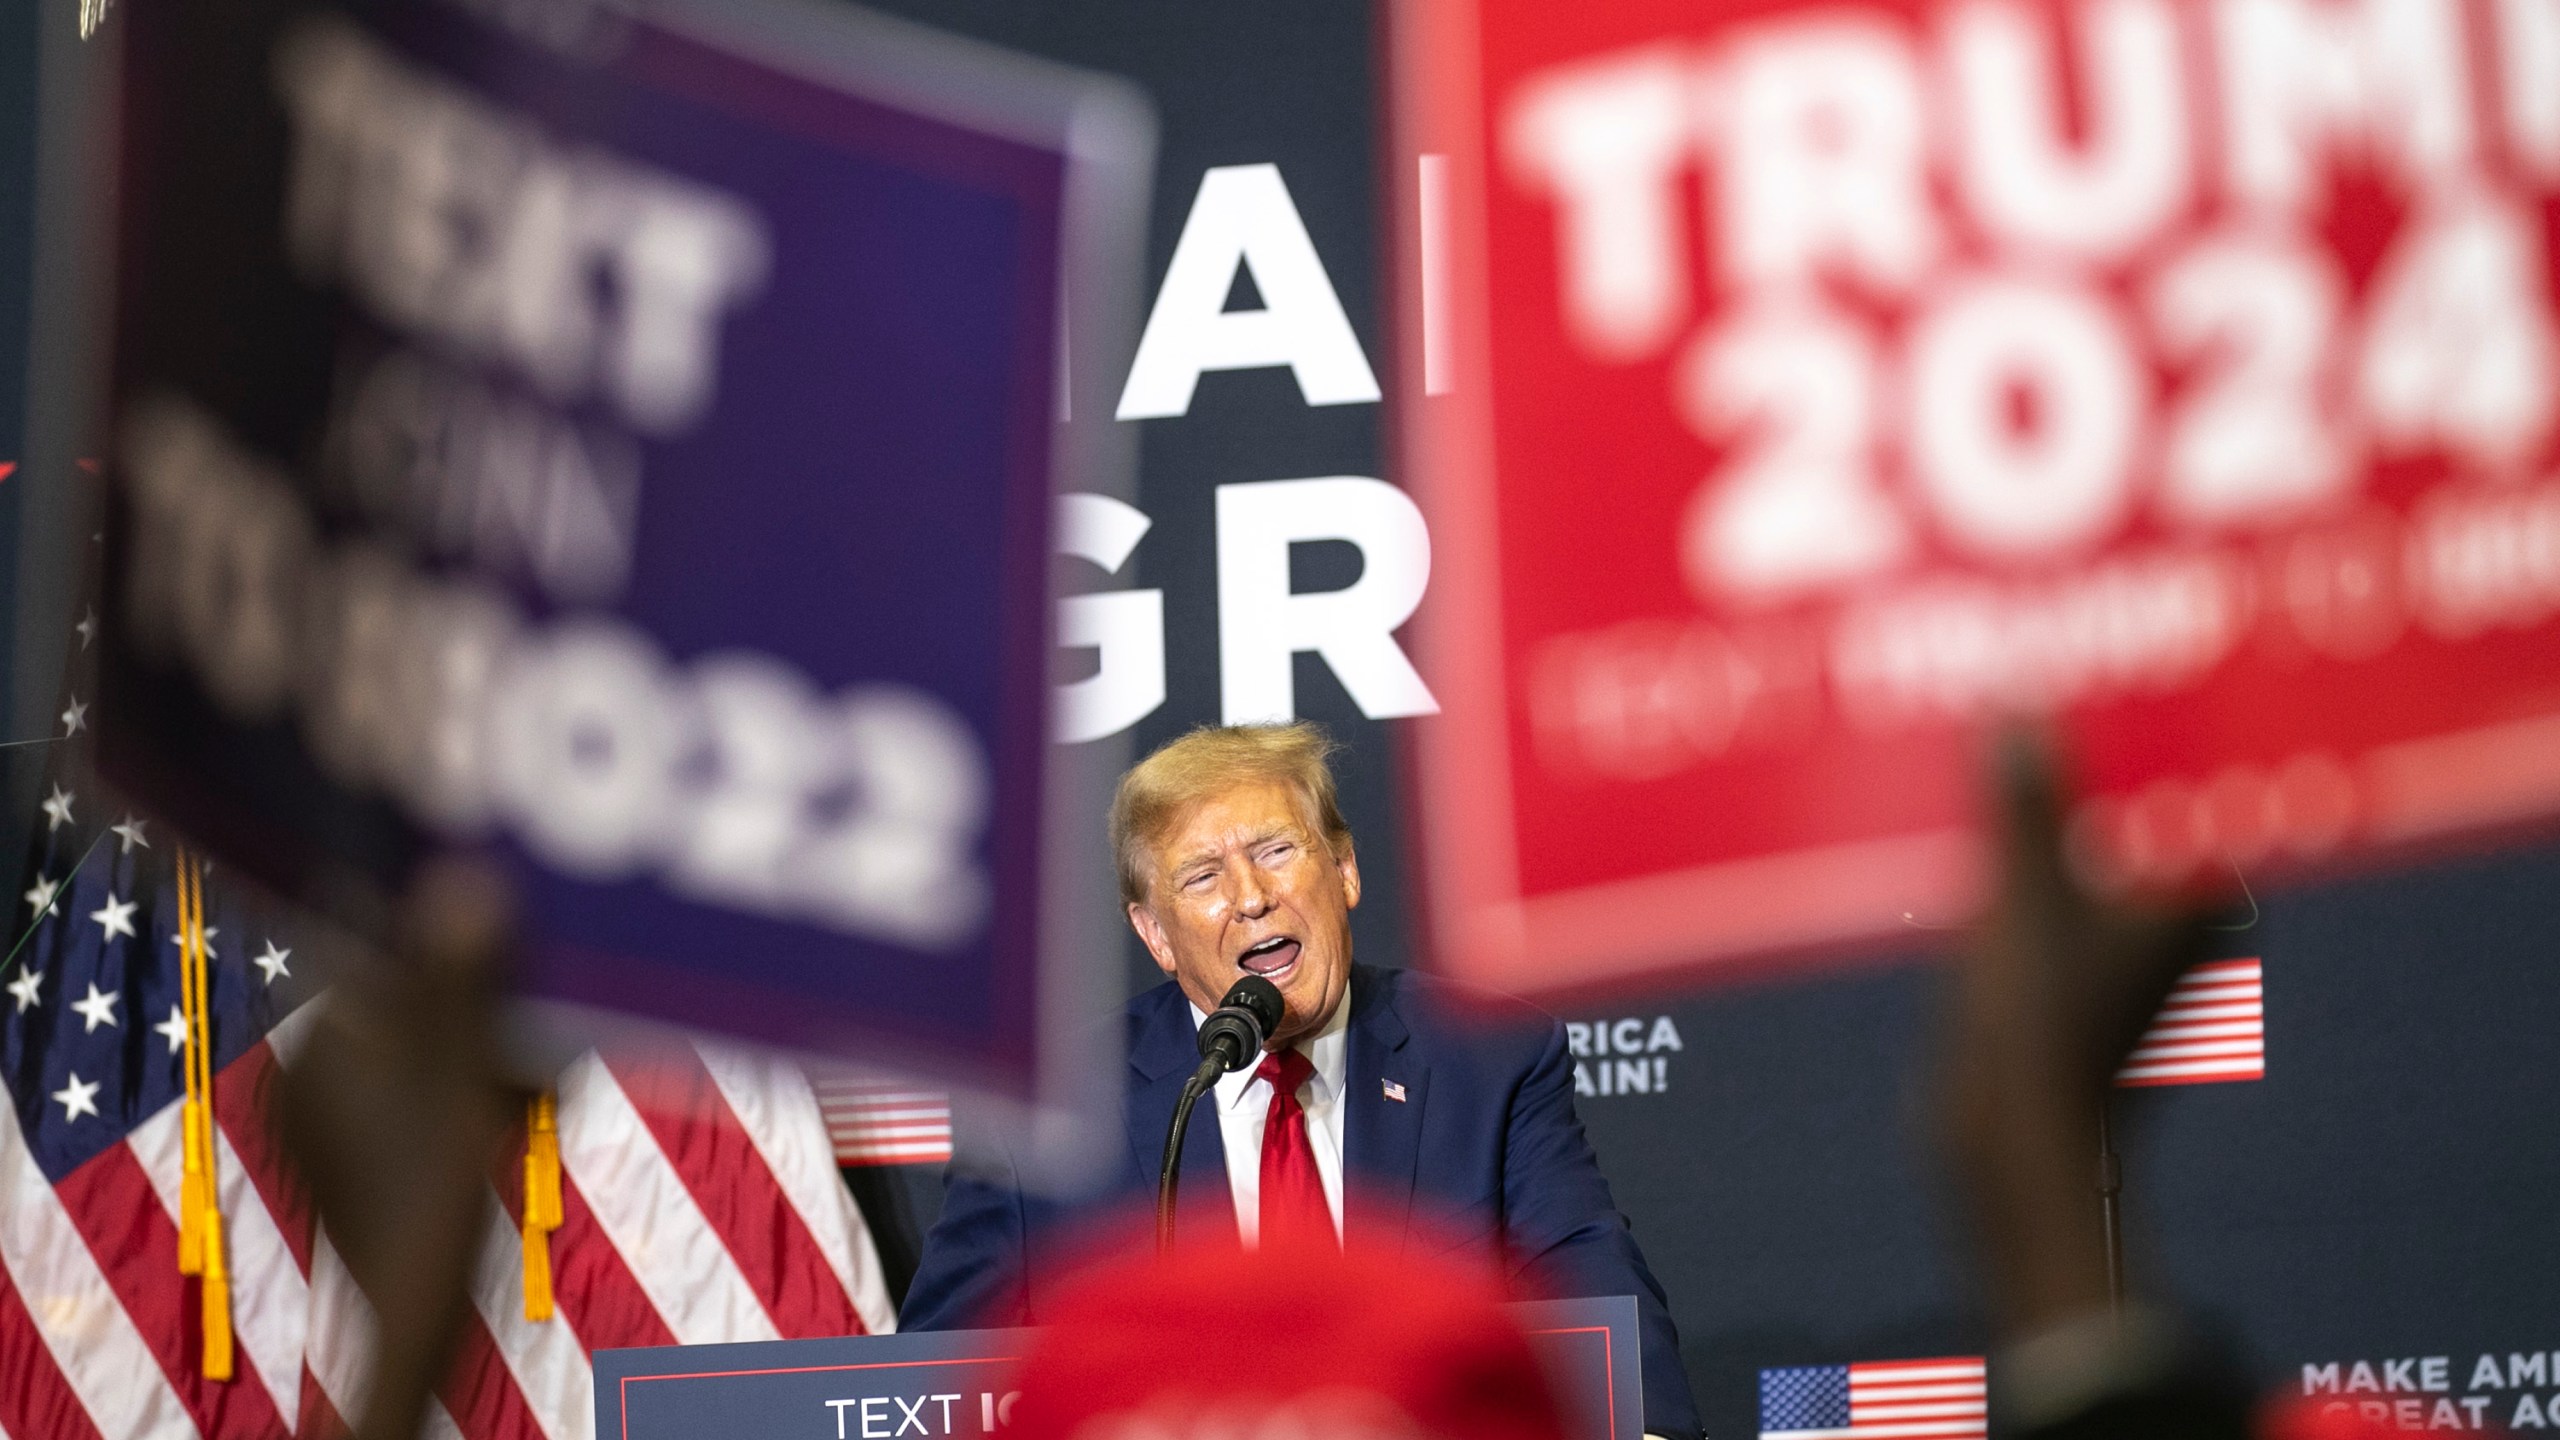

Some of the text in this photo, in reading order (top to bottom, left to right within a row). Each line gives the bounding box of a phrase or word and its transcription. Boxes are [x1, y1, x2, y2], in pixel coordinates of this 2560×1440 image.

[1676, 188, 2556, 600] 2024
[2302, 1356, 2450, 1396] MAKE
[825, 1393, 962, 1439] TEXT
